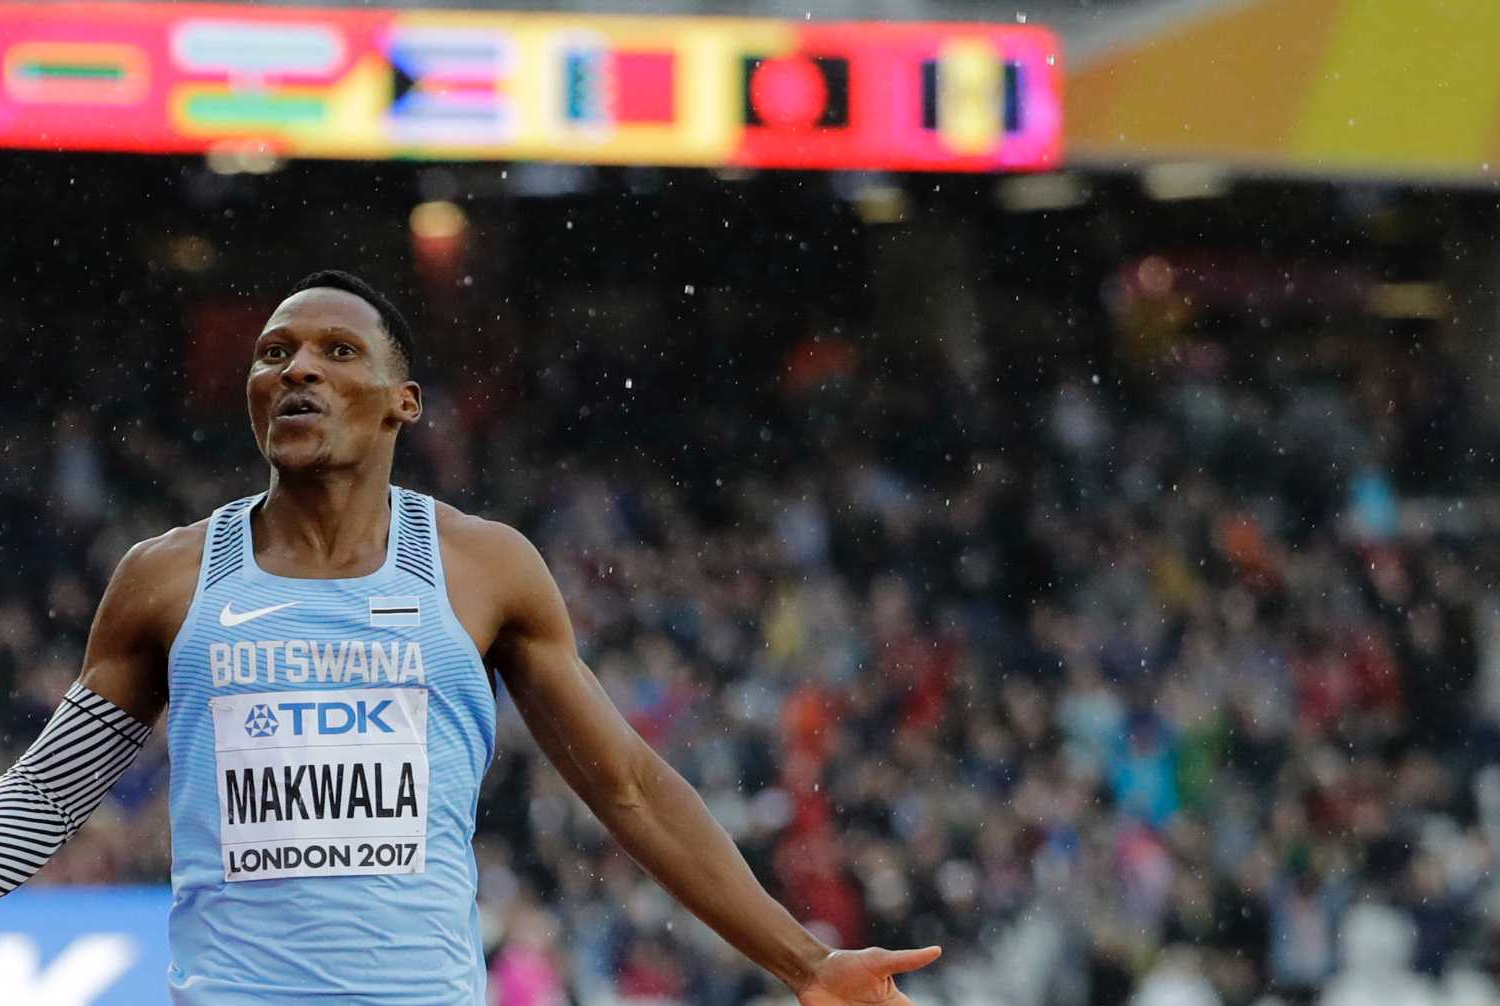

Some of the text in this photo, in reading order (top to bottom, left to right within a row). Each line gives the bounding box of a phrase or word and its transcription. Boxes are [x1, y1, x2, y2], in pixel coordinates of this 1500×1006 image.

[209, 640, 426, 687] BOTSWANA
[278, 700, 396, 735] TDK
[225, 762, 418, 825] MAKWALA
[229, 843, 418, 873] LONDON 2017
